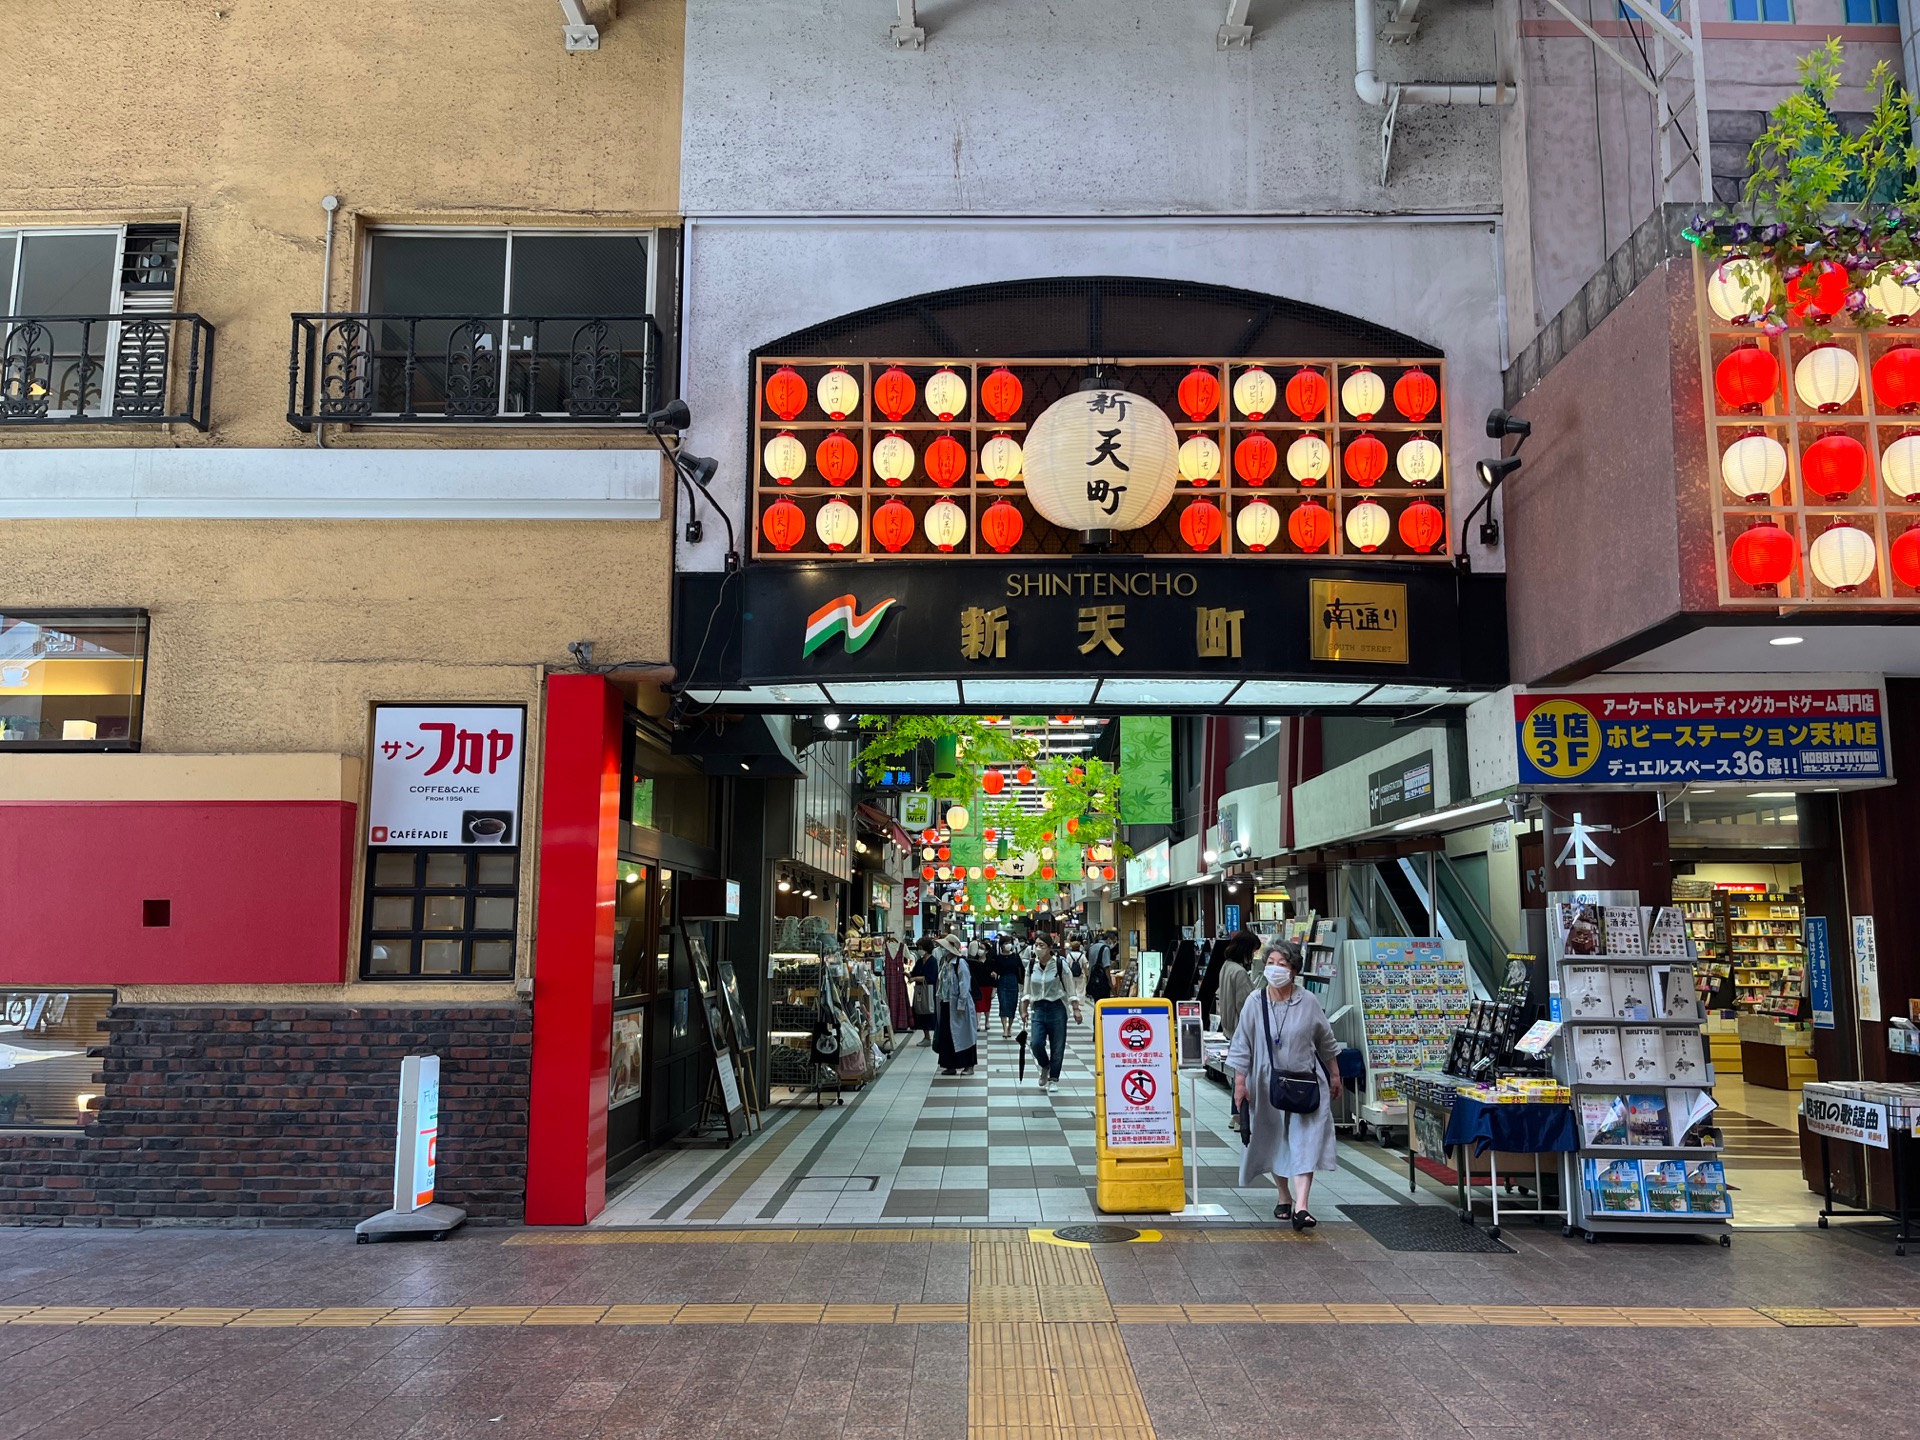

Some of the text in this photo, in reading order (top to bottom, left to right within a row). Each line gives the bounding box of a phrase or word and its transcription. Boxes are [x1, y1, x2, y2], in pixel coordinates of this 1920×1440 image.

[1086, 392, 1133, 515] 新天町
[1201, 440, 1210, 470] ドコモ
[1309, 440, 1321, 471] 新天町
[1006, 572, 1198, 597] SHINTENCHO
[1322, 597, 1397, 632] 南通り
[960, 604, 1246, 659] 新天町
[1328, 643, 1393, 653] SOUTH STREET
[1532, 712, 1590, 739] 当店
[1606, 721, 1877, 749] ホビーステーション天神店
[381, 722, 514, 776] サンフカヤ
[1536, 739, 1589, 768] 3F
[1607, 750, 1798, 776] デュエルスペース36席!!
[1802, 751, 1877, 764] HOBBYSTATION
[409, 785, 480, 794] COFFE&CAKE
[1370, 788, 1379, 811] 3F
[1553, 811, 1616, 880] 本
[1748, 893, 1764, 902] 文庫
[1865, 917, 1876, 973] 西日本新聞社
[1806, 1097, 1879, 1130] 昭和の歌謡曲
